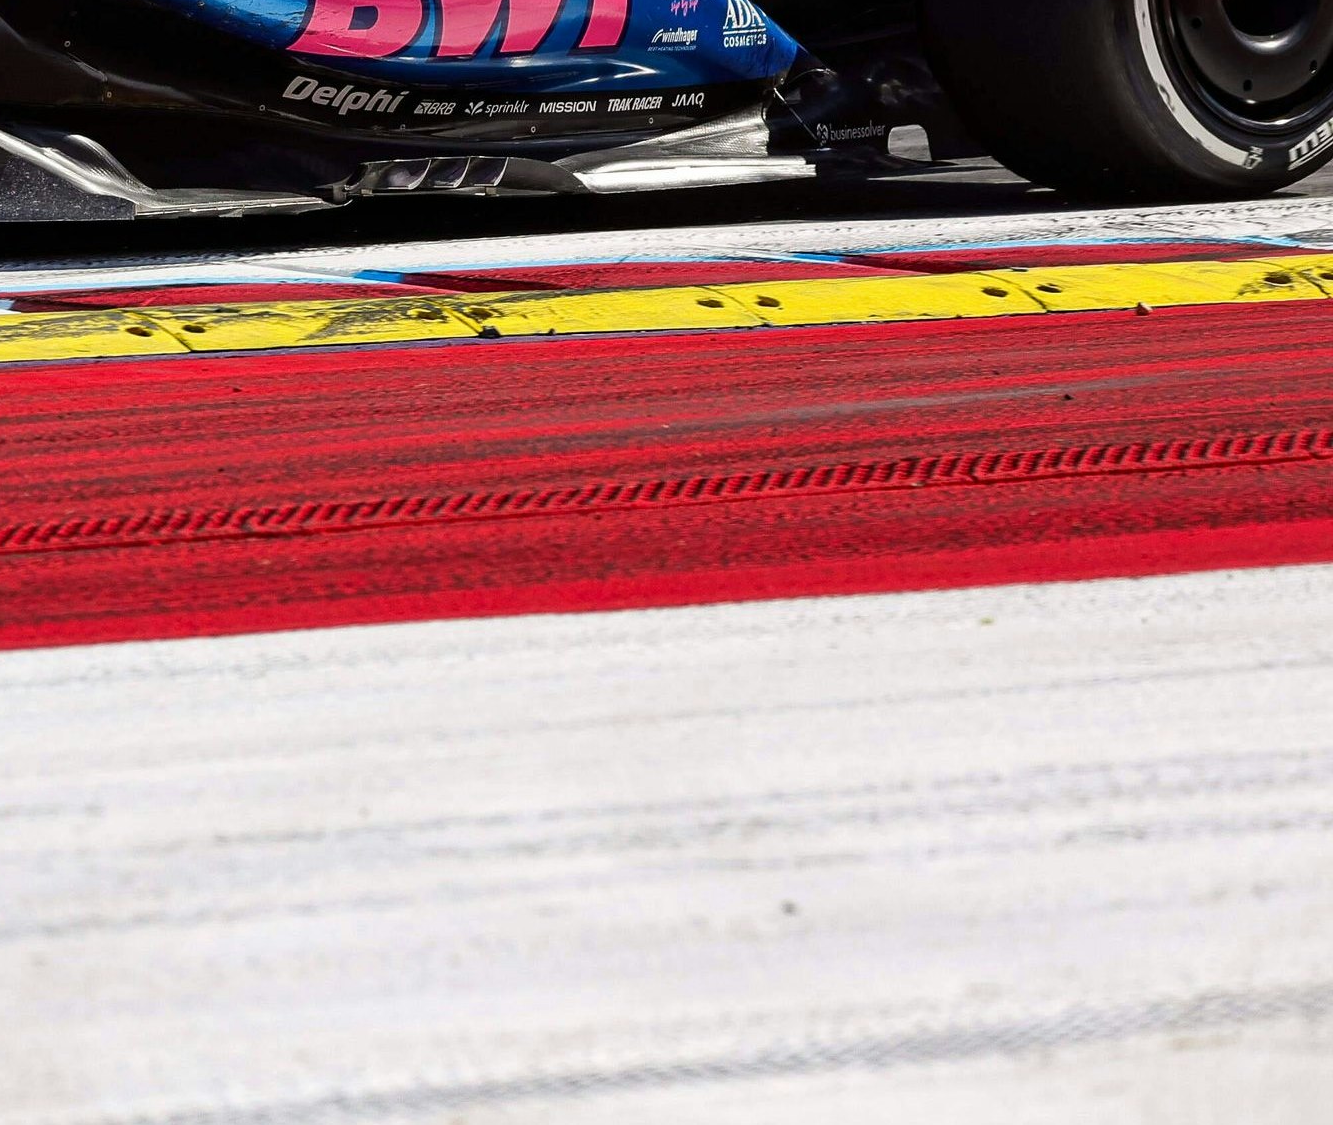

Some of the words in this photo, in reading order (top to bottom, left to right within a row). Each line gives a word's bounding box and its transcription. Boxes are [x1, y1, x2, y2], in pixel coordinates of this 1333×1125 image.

[661, 27, 699, 46] windhager
[282, 75, 410, 116] Delphi
[428, 101, 457, 115] BRB
[484, 99, 530, 117] sprinklr
[538, 100, 597, 114] MISSION
[607, 97, 632, 112] TRAK
[631, 96, 663, 111] RACER
[829, 119, 886, 141] businessolver
